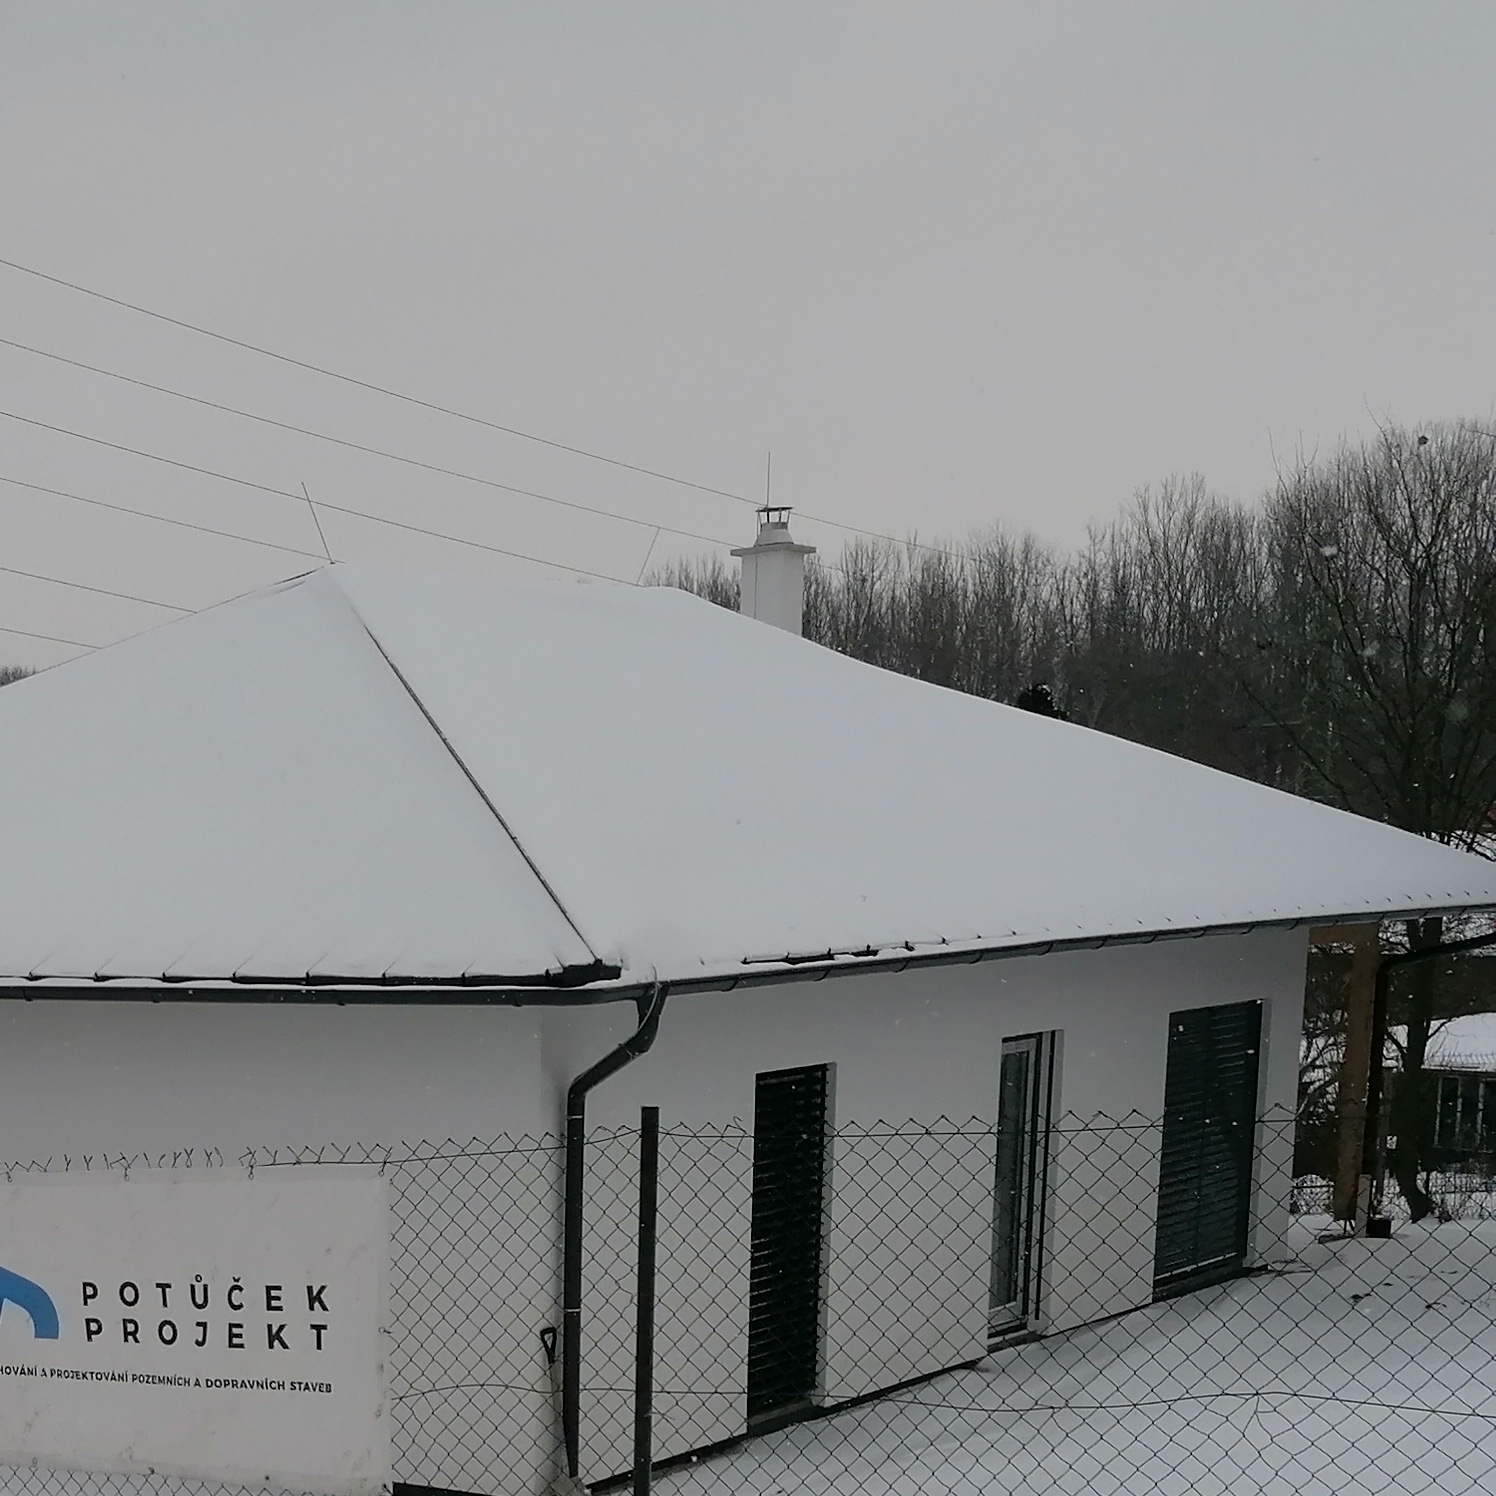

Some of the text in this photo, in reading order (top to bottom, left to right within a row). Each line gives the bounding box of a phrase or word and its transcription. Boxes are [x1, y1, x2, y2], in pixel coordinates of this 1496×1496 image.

[82, 1274, 329, 1312] POTŮČEK
[84, 1318, 328, 1350] PROJEKT
[40, 1367, 48, 1378] A
[50, 1368, 129, 1383] PROJEKTOVÁNÍ
[132, 1373, 190, 1387] POZEMNÍCH
[194, 1377, 202, 1388] A
[205, 1378, 285, 1391] DOPRAVNÍCH
[289, 1381, 332, 1393] STAVEB
